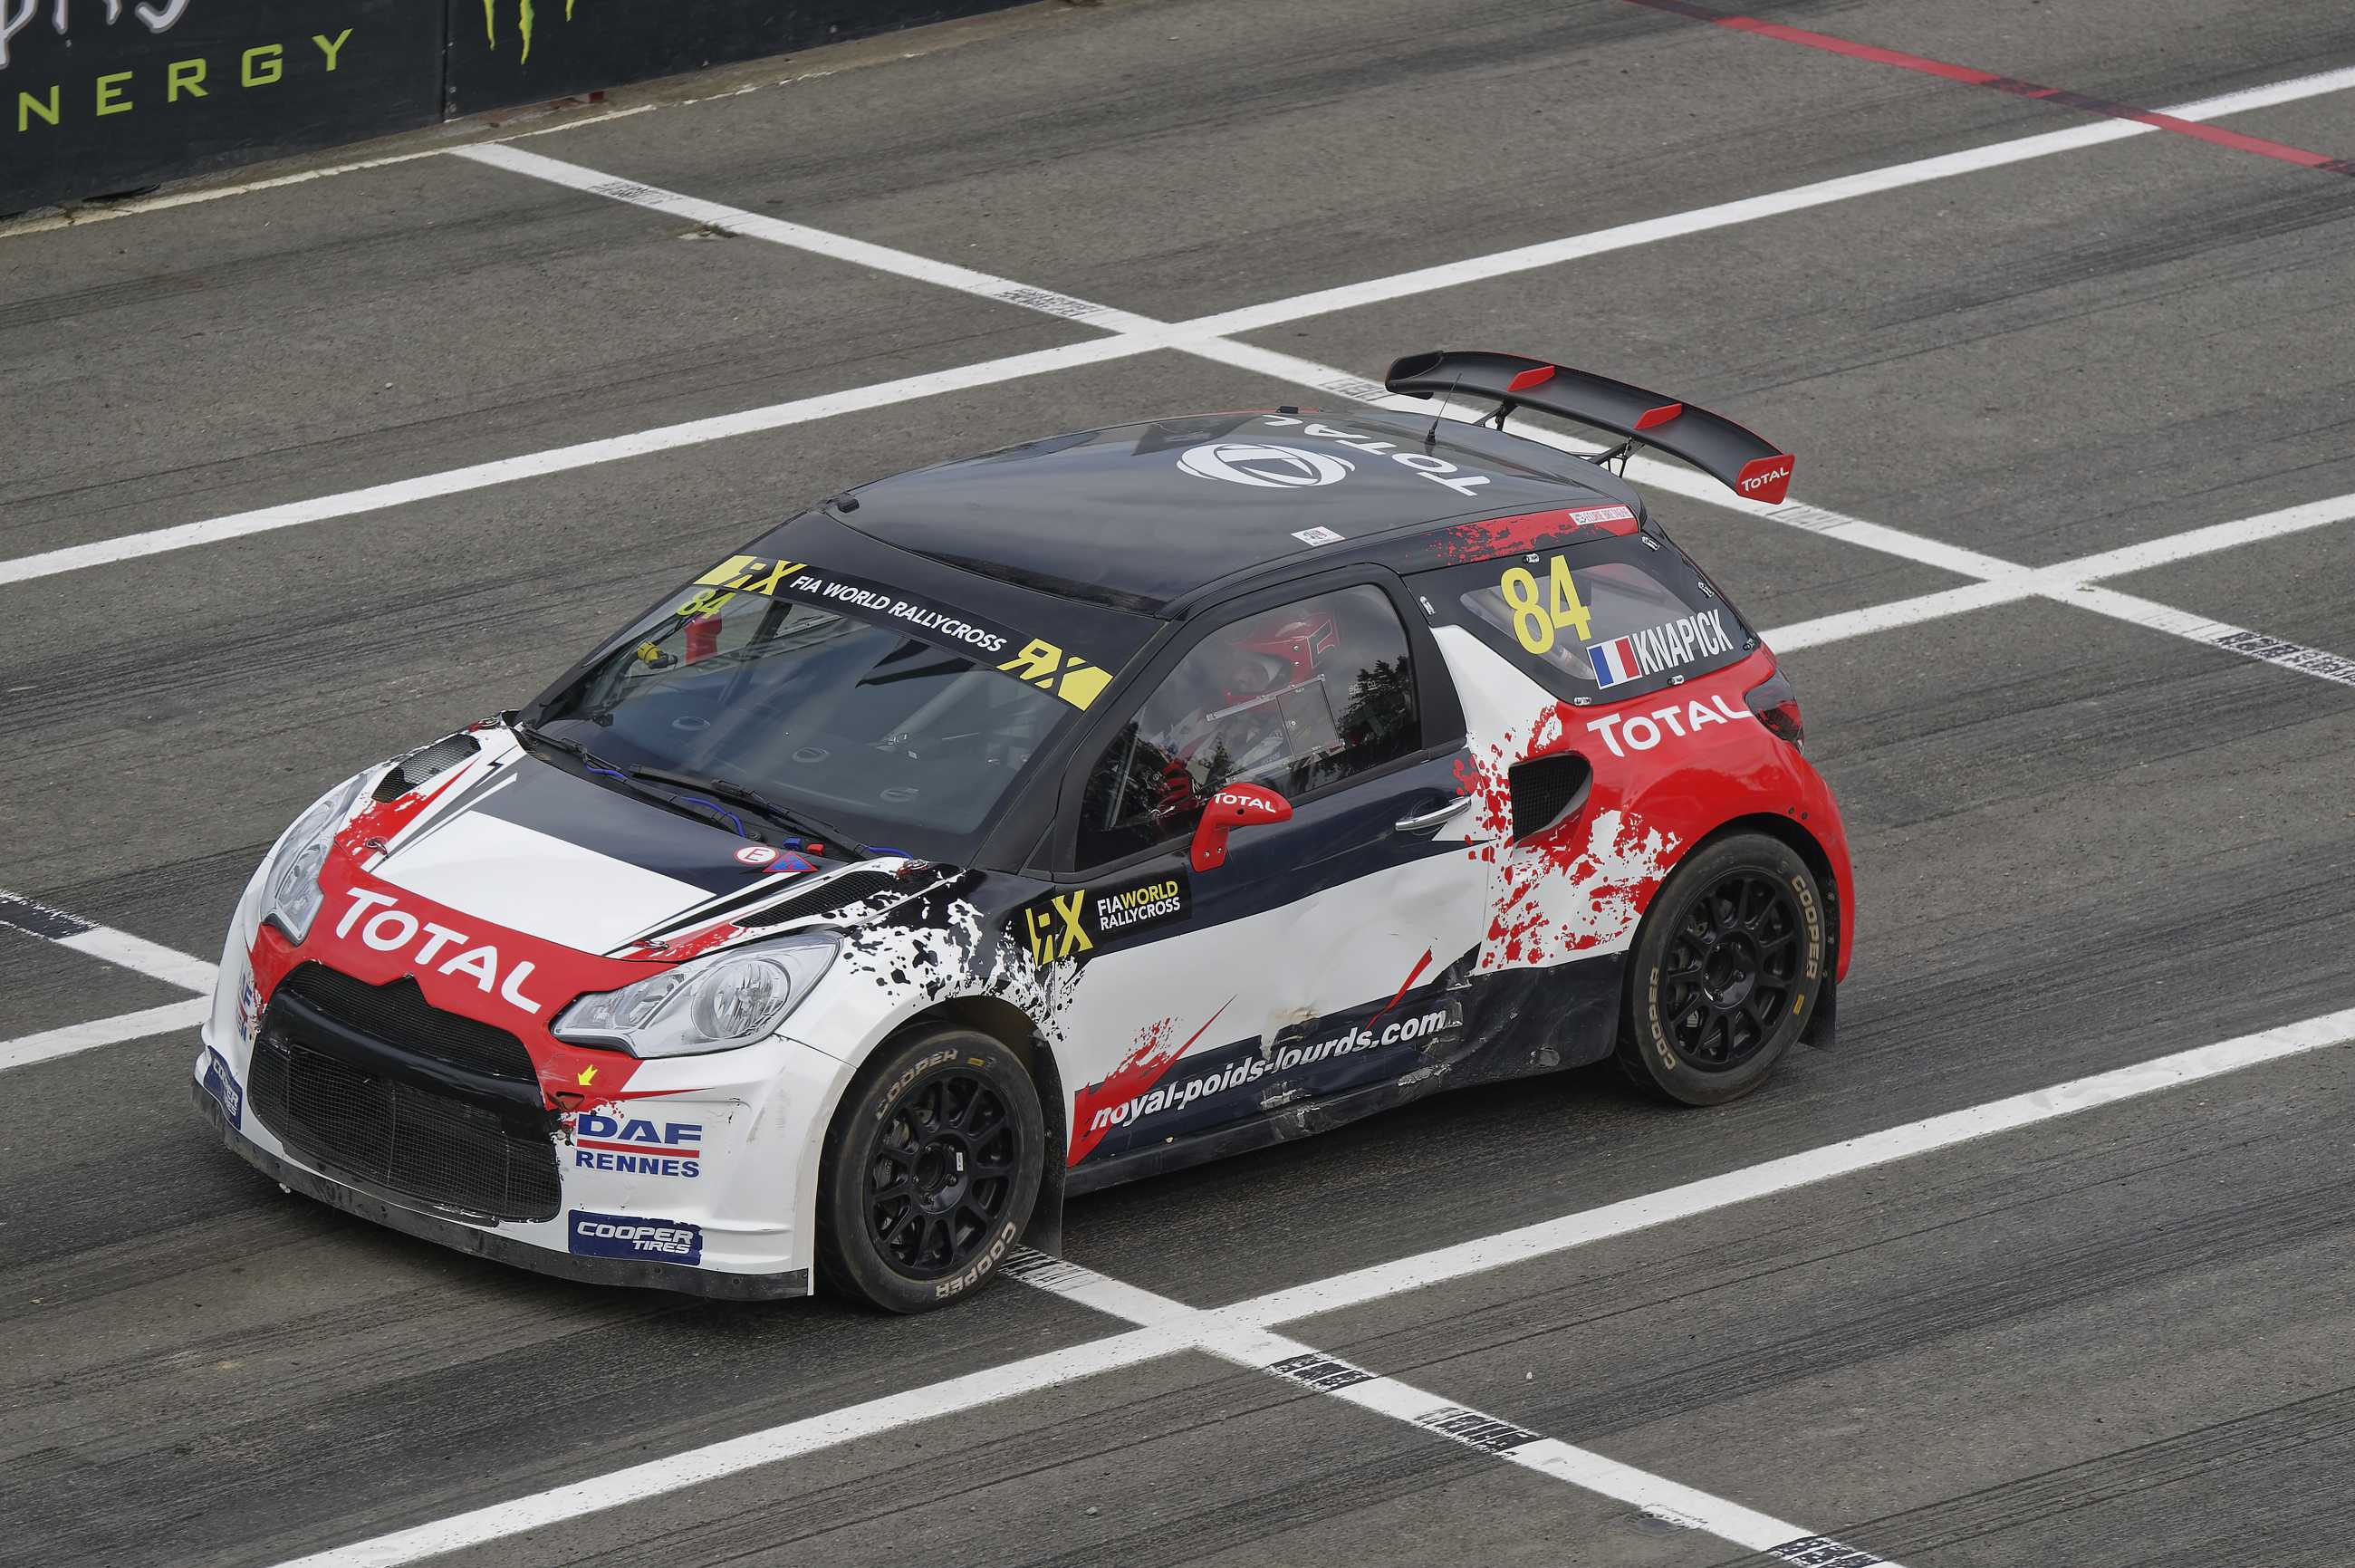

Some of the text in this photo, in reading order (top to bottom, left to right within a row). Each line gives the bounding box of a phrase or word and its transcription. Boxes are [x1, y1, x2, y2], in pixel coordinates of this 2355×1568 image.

[1262, 414, 1491, 496] TOTAL
[1741, 467, 1790, 492] TOTAL
[676, 588, 736, 620] 84
[790, 575, 1007, 653] FIA WORLD RALLYCROSS
[1500, 554, 1591, 655] 84
[1632, 609, 1734, 676] KNAPICK
[1586, 695, 1754, 757] TOTAL
[1214, 792, 1276, 813] TOTAL
[744, 848, 769, 861] E
[1101, 896, 1181, 931] RALLYCROSS
[1792, 874, 1820, 979] COOPER
[336, 886, 542, 1015] TOTAL
[1648, 967, 1676, 1071] COOPER
[875, 1048, 957, 1121] COOPER
[1091, 1009, 1447, 1130] noyal-poids-lourds.com
[577, 1112, 703, 1145] DAF
[575, 1150, 700, 1178] RENNES
[577, 1221, 694, 1245] COOPER
[632, 1240, 690, 1255] TIRES
[935, 1221, 1016, 1299] COOPER
